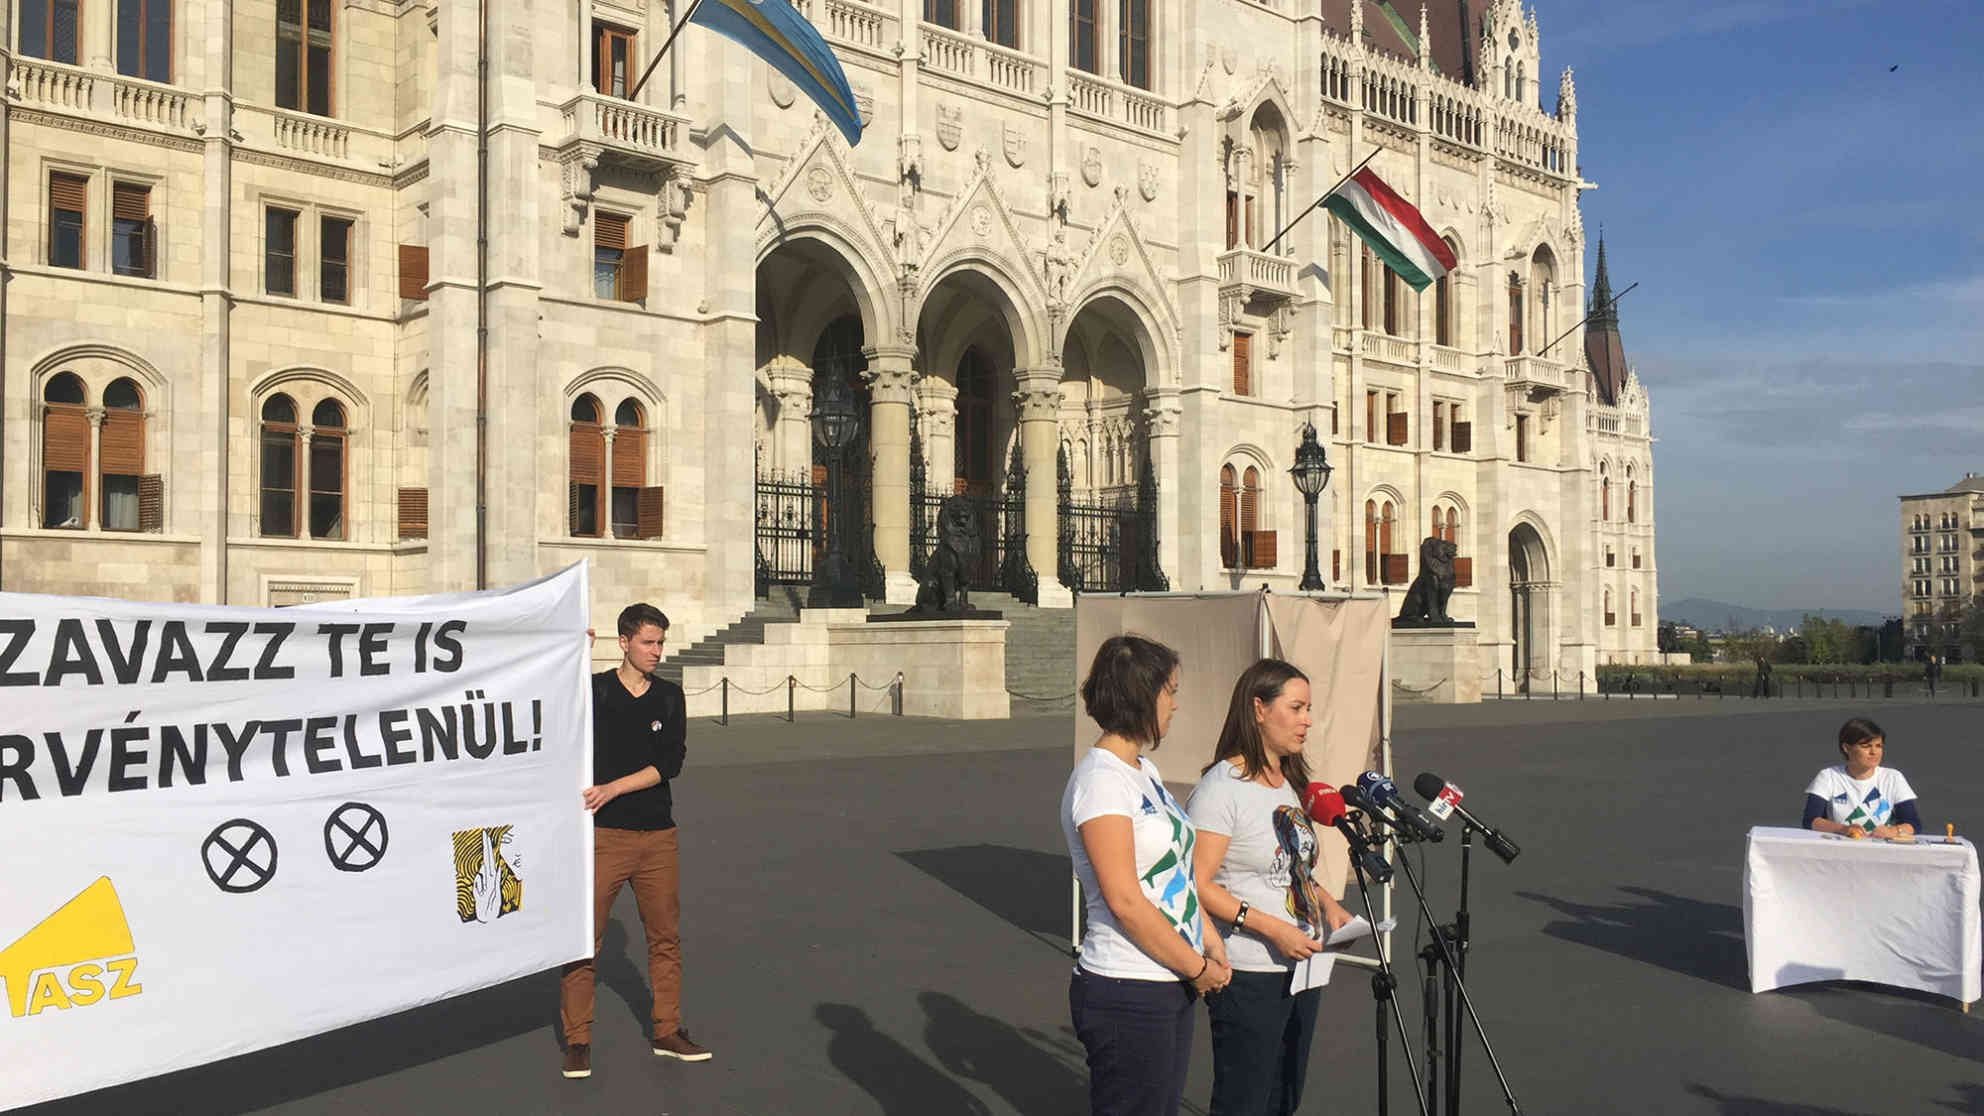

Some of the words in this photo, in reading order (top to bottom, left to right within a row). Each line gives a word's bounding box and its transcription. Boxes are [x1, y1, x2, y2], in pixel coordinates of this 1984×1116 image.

[0, 618, 296, 687] ZAVAZZ
[318, 621, 394, 678] TE
[414, 619, 468, 674] IS
[0, 689, 543, 802] RVÉNYTELENÜL!
